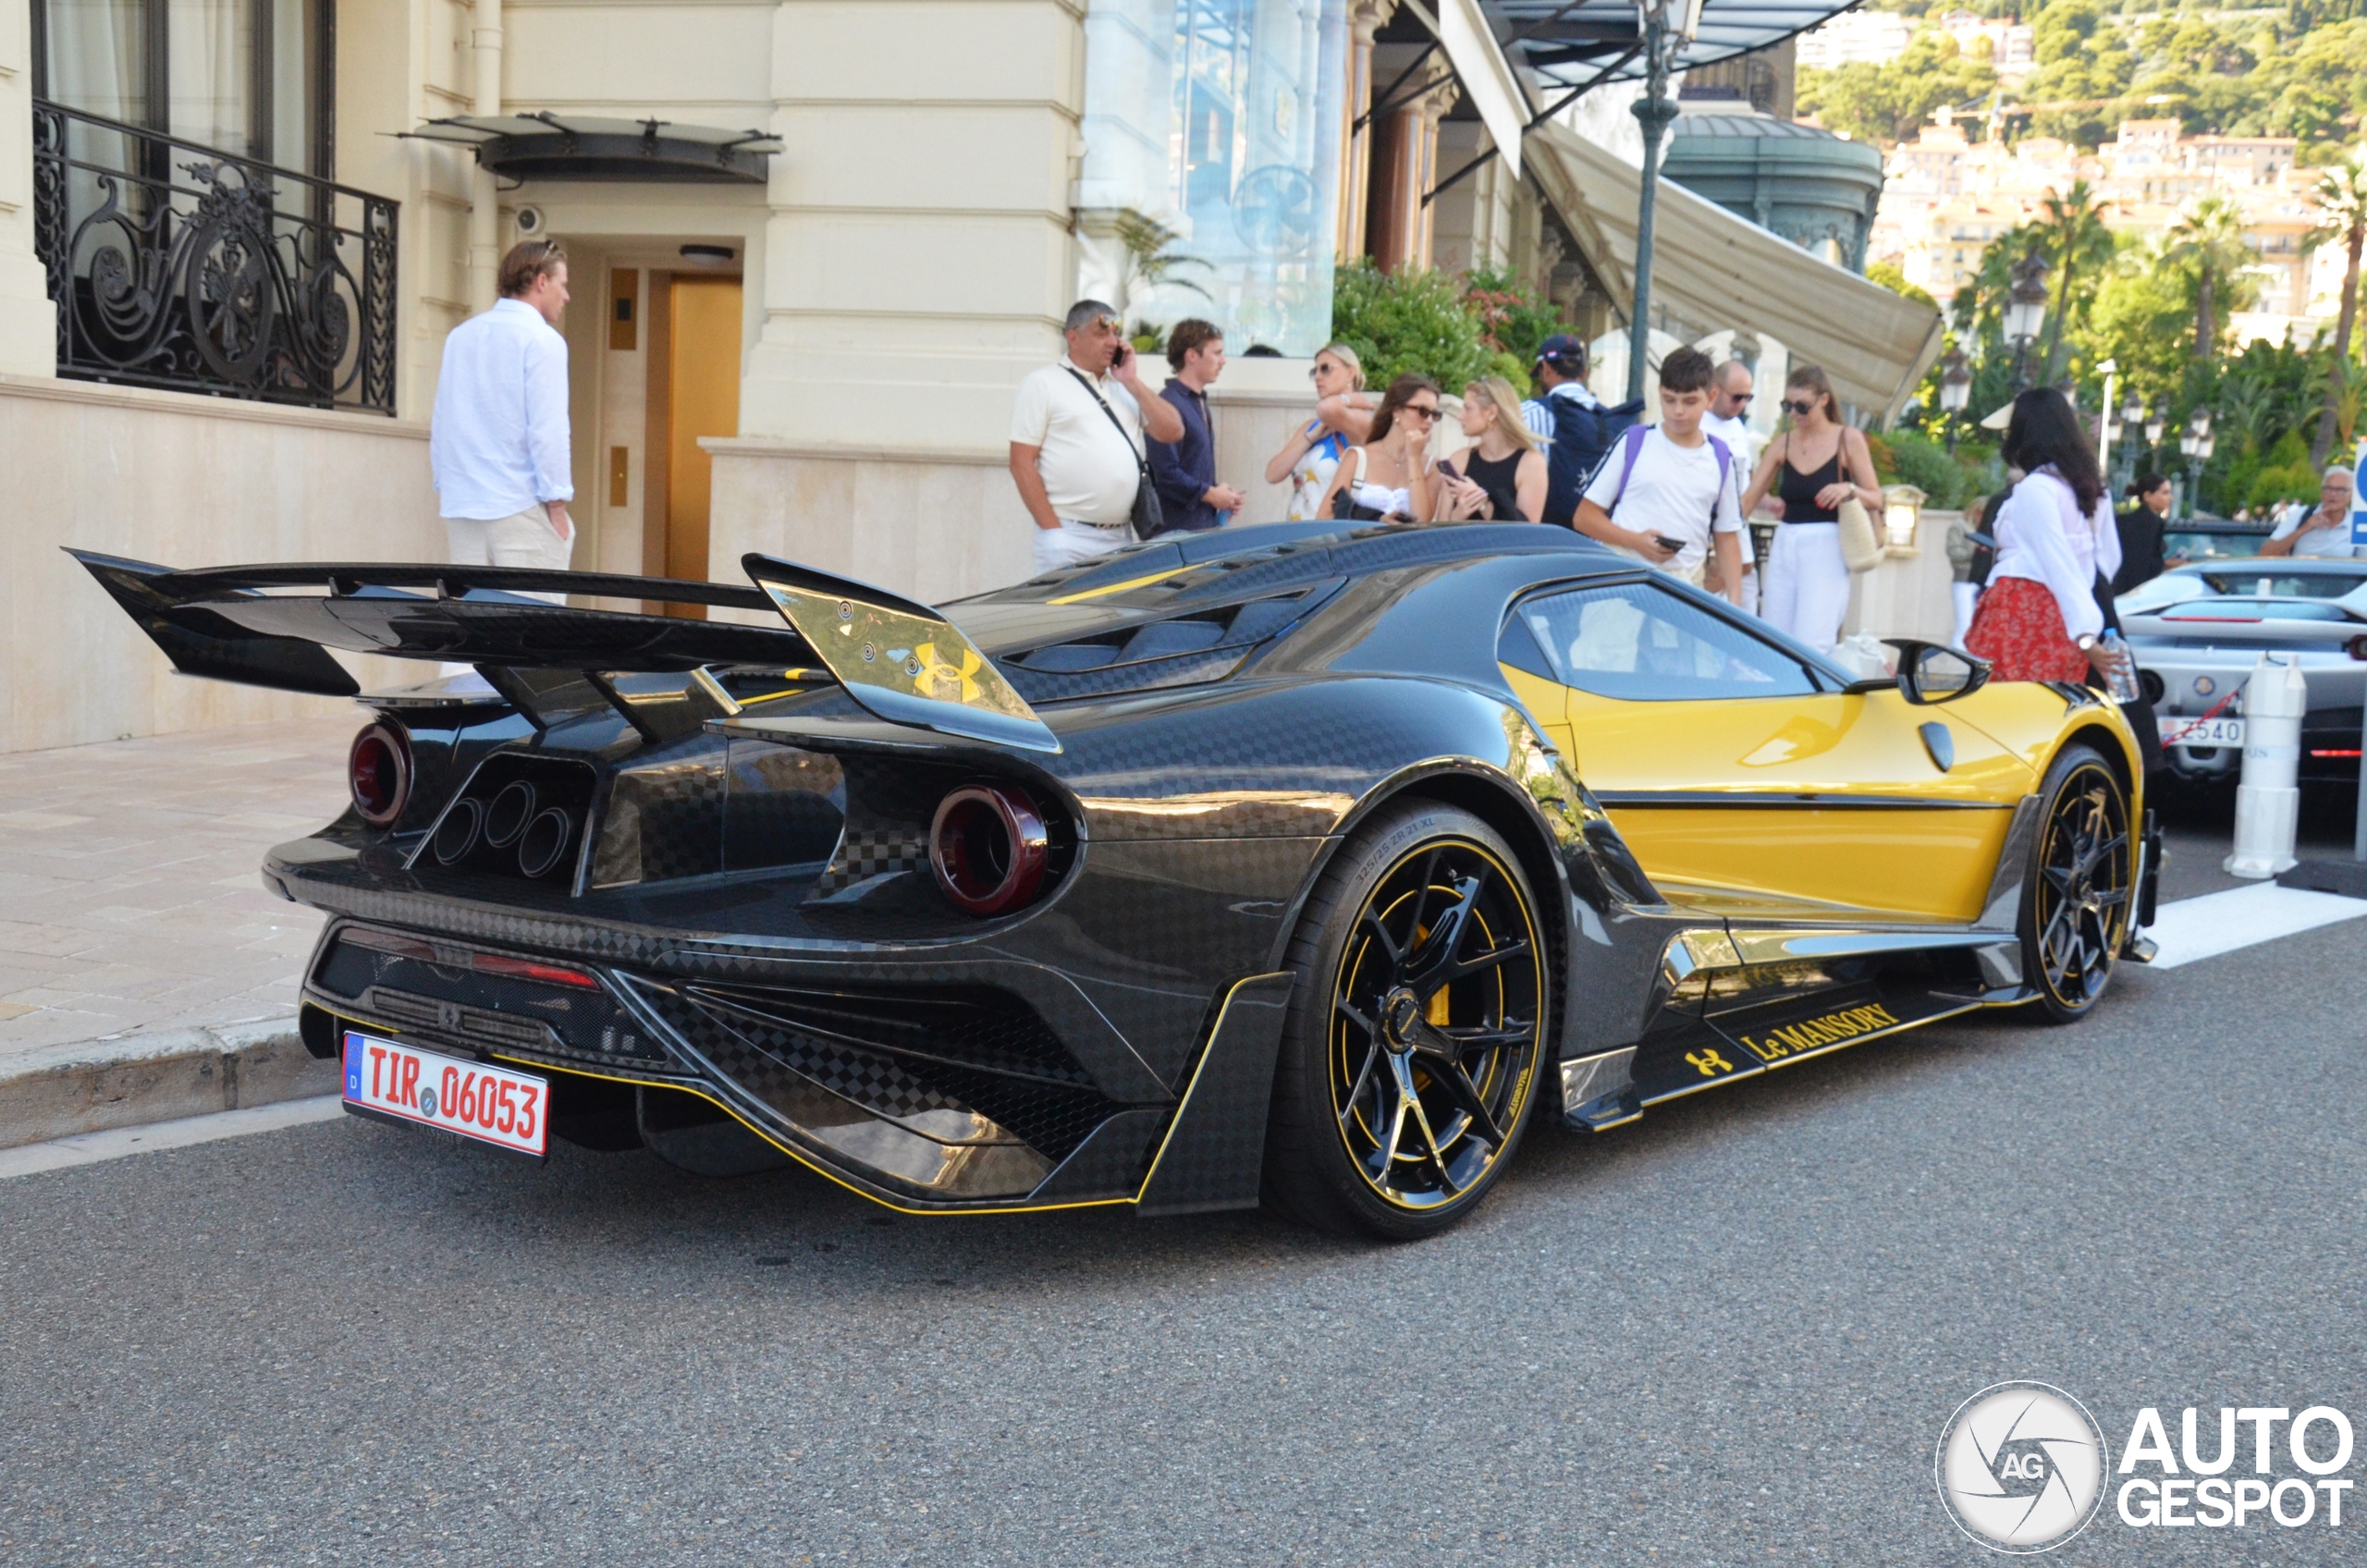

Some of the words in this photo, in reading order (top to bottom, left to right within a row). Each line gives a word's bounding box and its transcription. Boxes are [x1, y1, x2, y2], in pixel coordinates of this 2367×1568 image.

[1355, 844, 1390, 885] 325/25
[1390, 831, 1404, 846] ZR
[1407, 824, 1418, 836] 21
[1421, 817, 1436, 828] XL
[1740, 1035, 1788, 1061] Le
[1771, 1003, 1901, 1052] MANSORY
[350, 1074, 358, 1090] D
[369, 1047, 421, 1109] TIR
[440, 1066, 539, 1140] 06053
